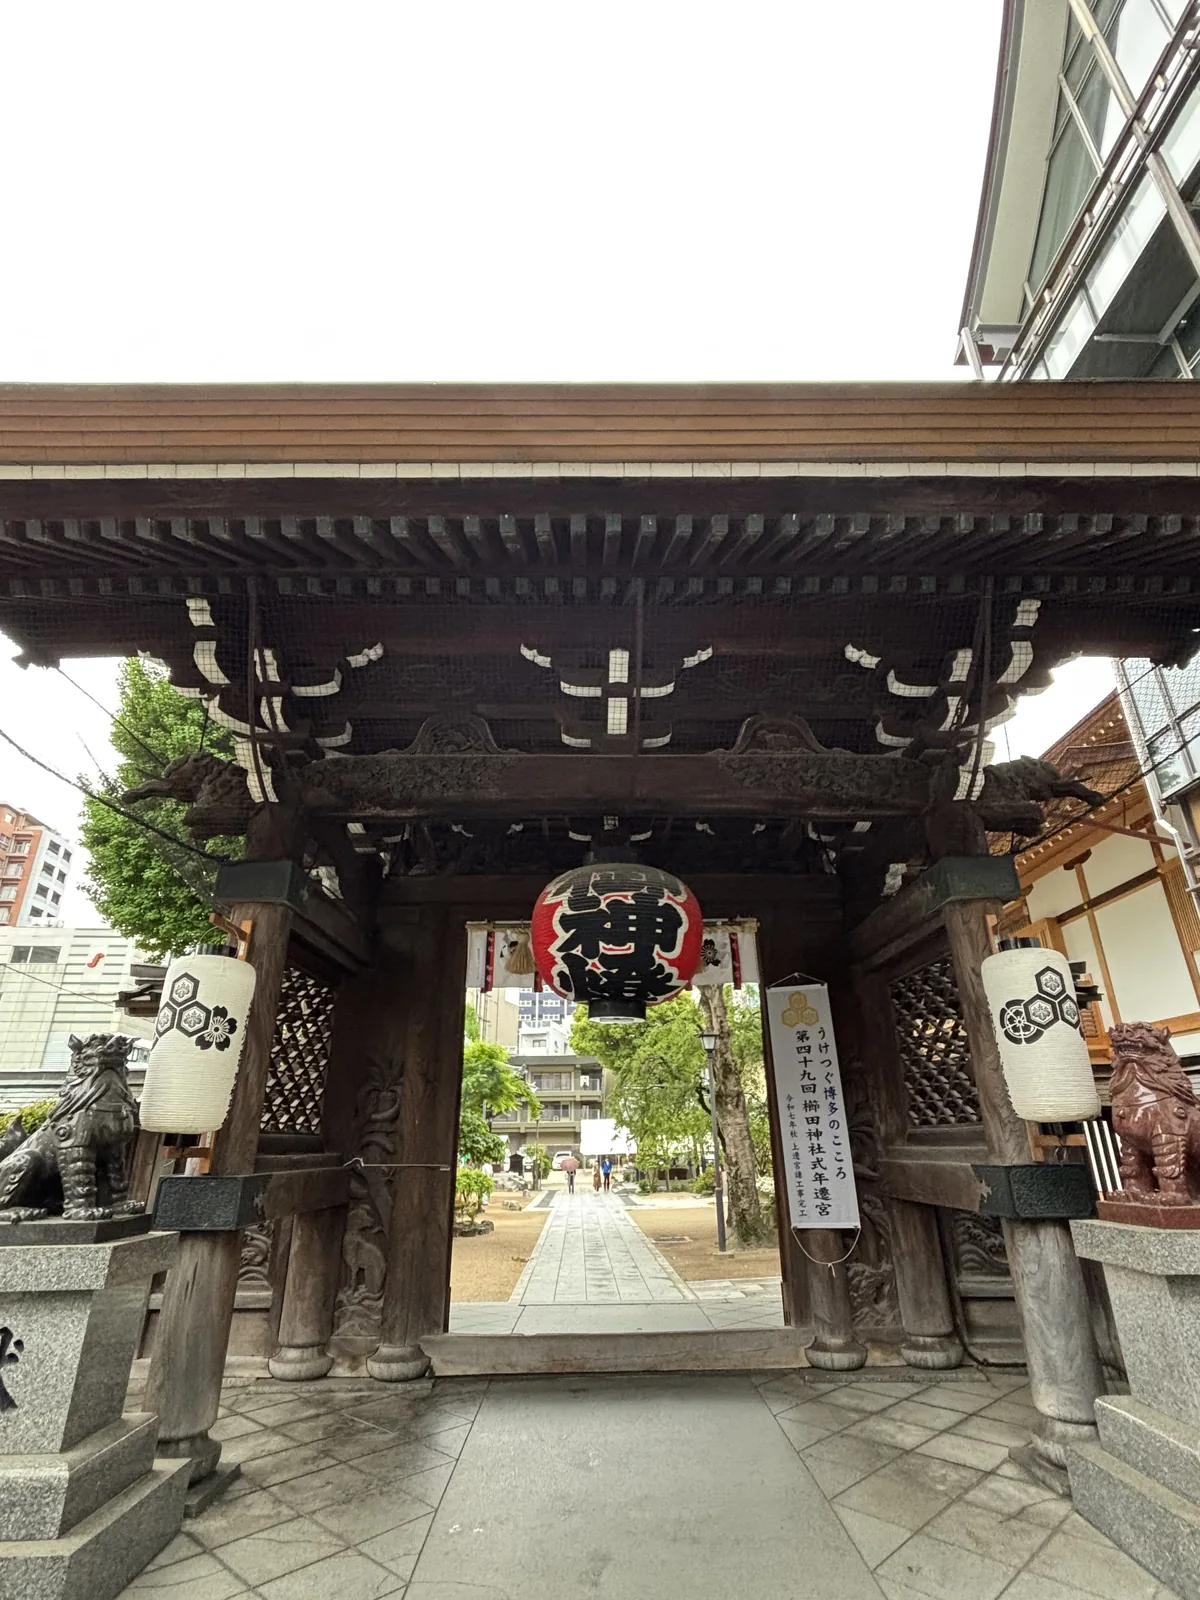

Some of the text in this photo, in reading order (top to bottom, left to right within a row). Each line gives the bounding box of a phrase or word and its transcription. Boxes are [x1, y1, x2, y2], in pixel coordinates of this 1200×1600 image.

[817, 1026, 847, 1180] うけつぐ博多のこころ
